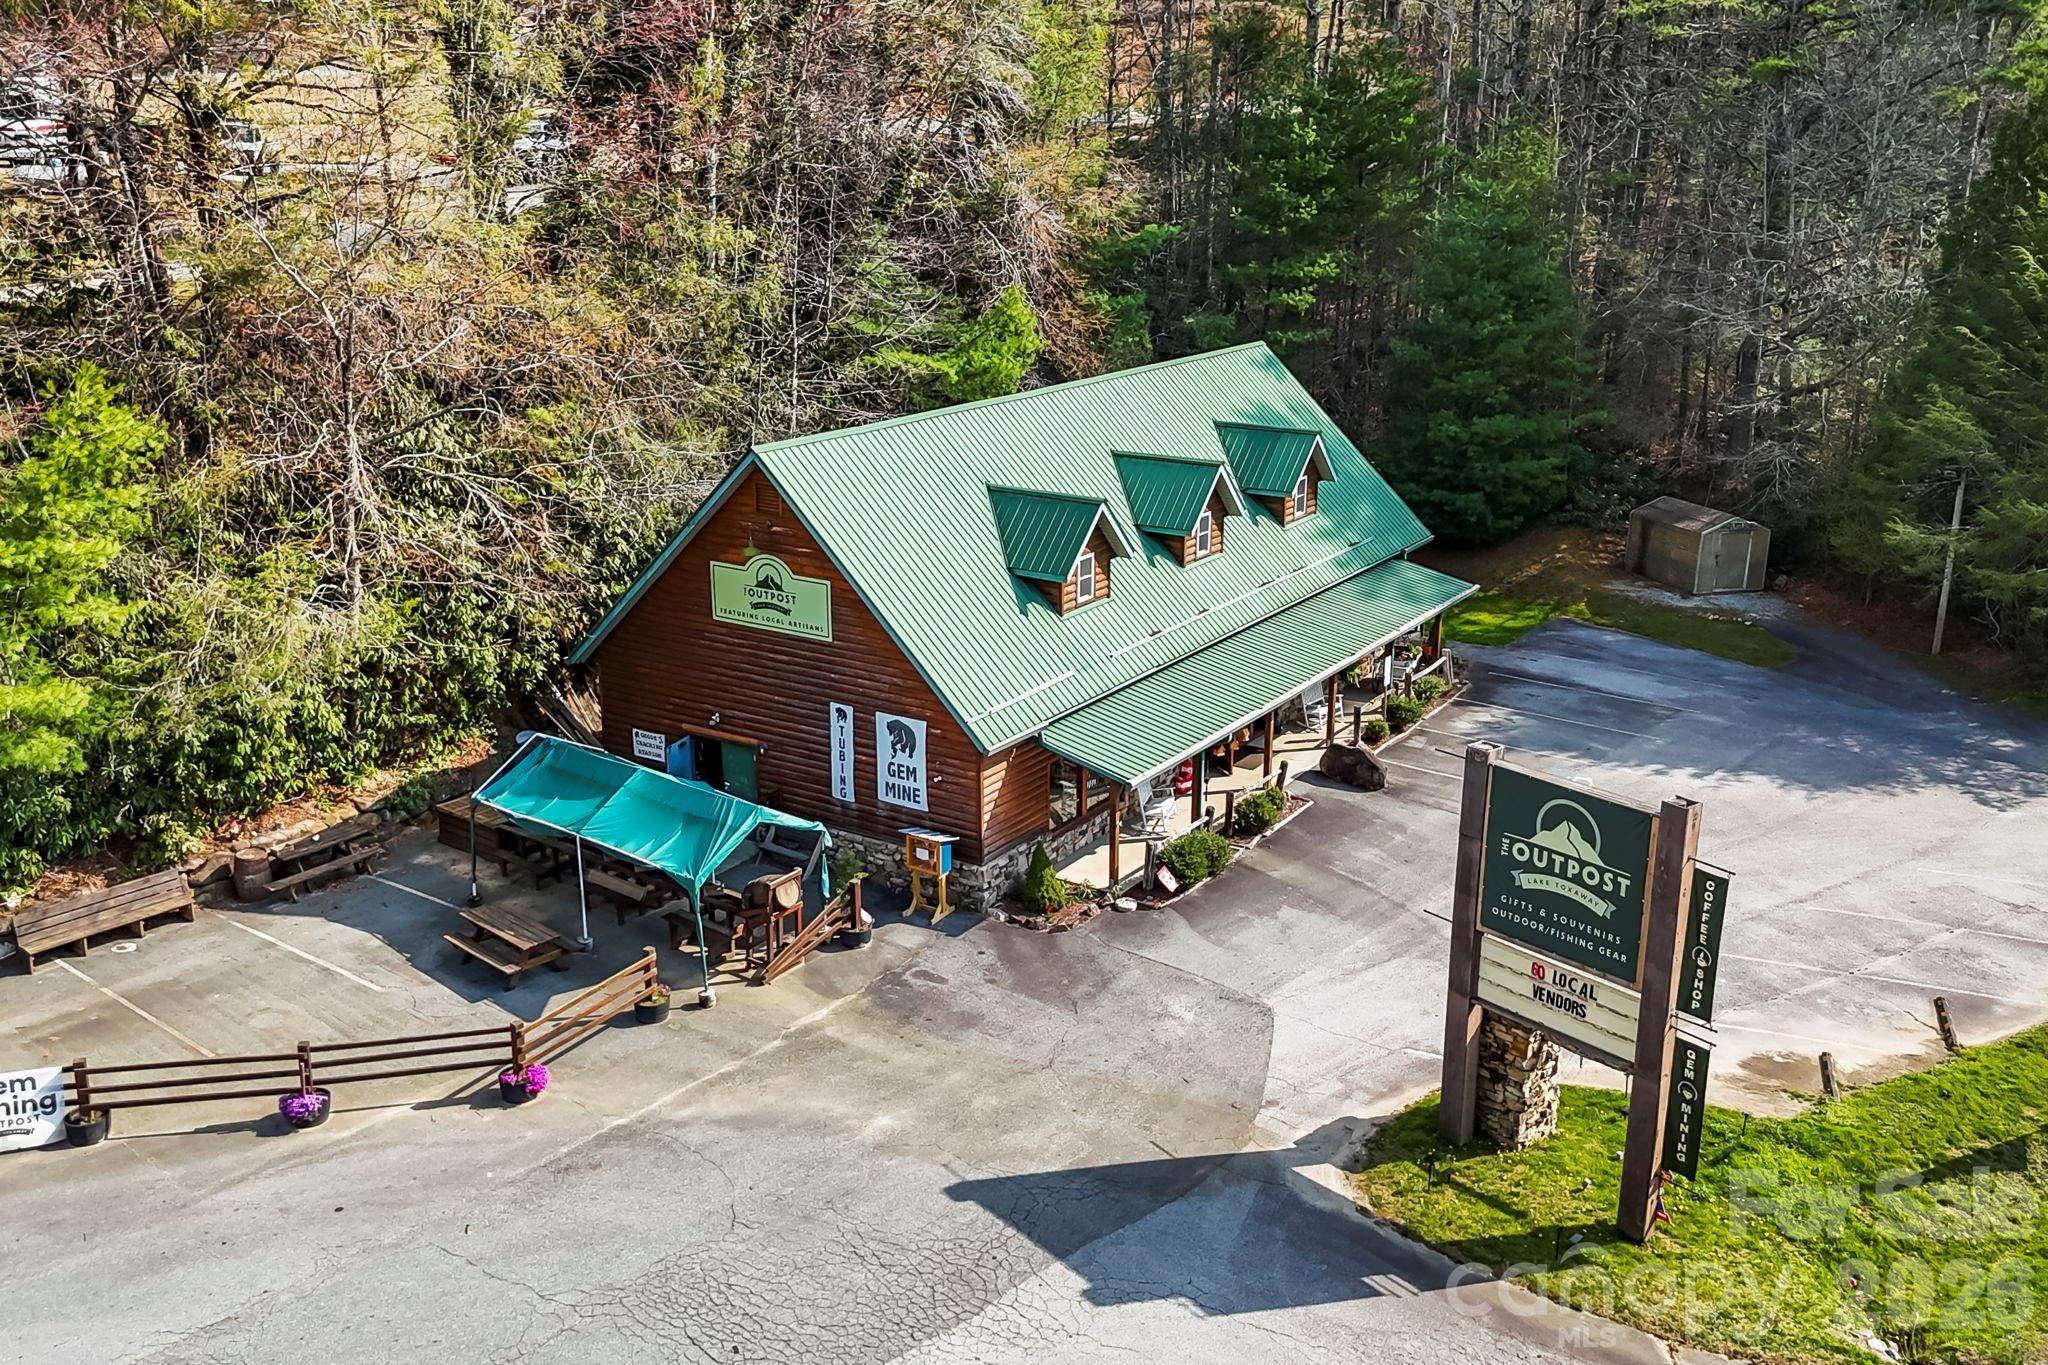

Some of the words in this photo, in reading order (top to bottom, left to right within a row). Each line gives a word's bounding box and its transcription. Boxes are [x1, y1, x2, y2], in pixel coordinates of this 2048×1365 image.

[748, 588, 797, 605] OUTPOST
[720, 607, 759, 620] FEATURING
[761, 615, 785, 626] LOCAL
[788, 621, 824, 632] ARTISANS
[838, 725, 847, 798] TUBING
[887, 761, 918, 783] GEM
[885, 781, 921, 805] MINE
[1500, 837, 1510, 856] THE
[1511, 842, 1631, 898] OUTPOST
[1527, 877, 1549, 887] LAKE
[1554, 881, 1599, 907] TOXAWAY
[1500, 894, 1533, 912] GIFTS
[1539, 908, 1546, 918] &
[1553, 912, 1621, 945] SOUVENIRS
[1699, 880, 1715, 946] COFFEE
[1492, 906, 1594, 951] OUTDOOR/FISHING
[1598, 946, 1627, 963] GEAR
[1532, 983, 1587, 1019] VENDORS
[1552, 970, 1598, 1001] LOCAL
[1691, 968, 1704, 1010] SHOP
[1684, 1049, 1696, 1080] GEM
[1676, 1102, 1692, 1162] MINING
